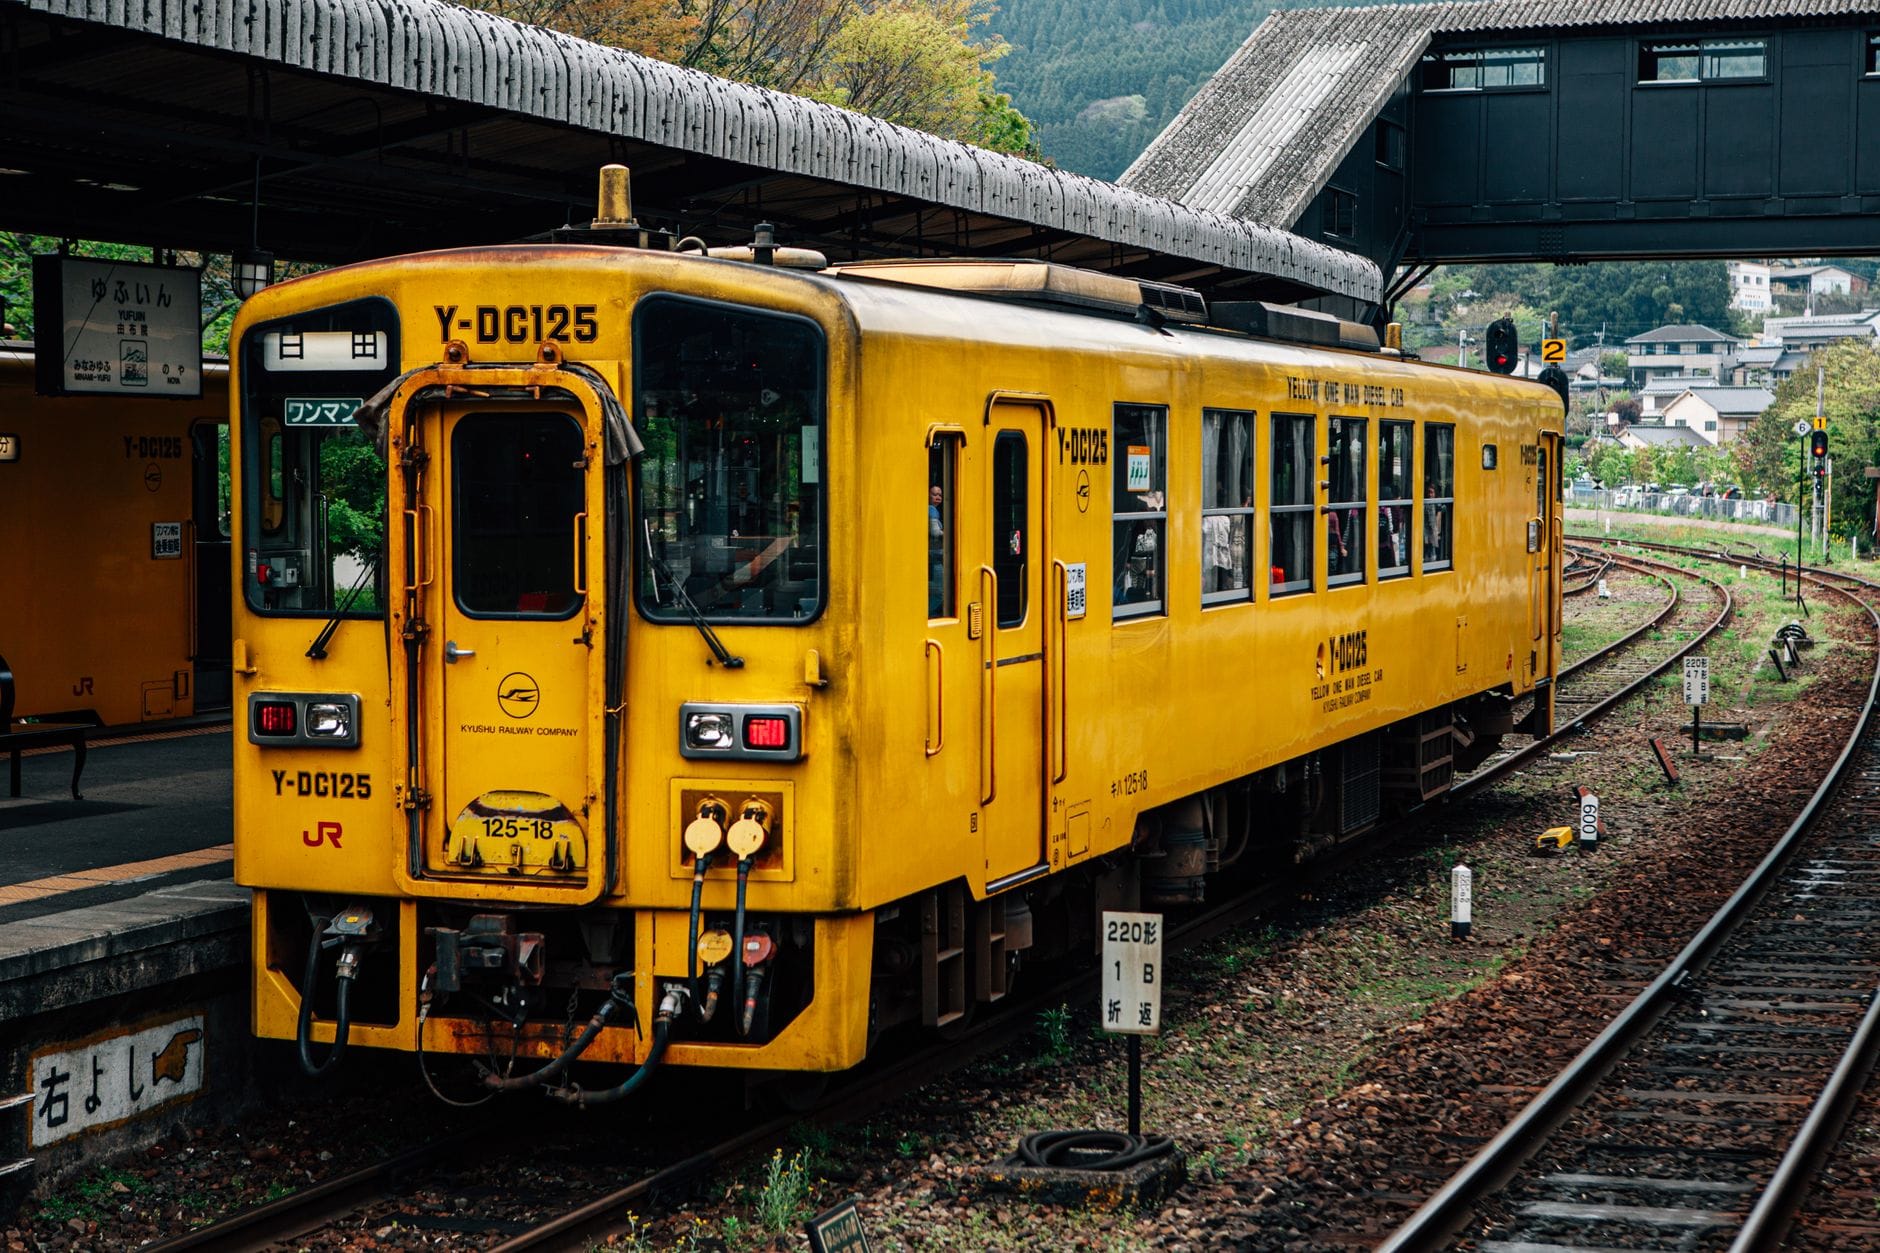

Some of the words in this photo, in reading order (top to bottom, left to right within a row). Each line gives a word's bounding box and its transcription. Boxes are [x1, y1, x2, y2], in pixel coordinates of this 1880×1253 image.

[91, 278, 171, 308] ゆふいん
[118, 310, 146, 321] YUFUIN
[434, 304, 598, 344] Y-DC125
[117, 323, 148, 337] 由布院
[1544, 341, 1563, 361] 2
[74, 360, 111, 373] みなみゆふ
[162, 363, 185, 377] のや
[1287, 376, 1319, 400] YELLOW
[1325, 381, 1339, 402] ONE
[1344, 383, 1359, 404] MAN
[1364, 385, 1386, 406] DIESEL
[1391, 388, 1404, 407] CAR
[288, 402, 358, 423] ワンマン
[1799, 423, 1806, 432] 6
[124, 436, 181, 458] Y-DC125
[1057, 426, 1107, 465] Y-DC125
[1329, 630, 1367, 675] Y-DC125
[73, 677, 93, 696] JR
[461, 725, 496, 733] KYUSHU
[499, 726, 534, 735] RAILWAY
[537, 728, 578, 736] COMPANY
[272, 770, 371, 800] Y-DC125
[1111, 780, 1123, 799] キハ
[1124, 769, 1148, 796] 125-18
[482, 818, 553, 839] 125-18
[1583, 804, 1597, 834] 600
[303, 821, 342, 849] JR
[1108, 921, 1157, 945] 220形
[1108, 999, 1151, 1026] 折返
[39, 1045, 145, 1128] 右よし
